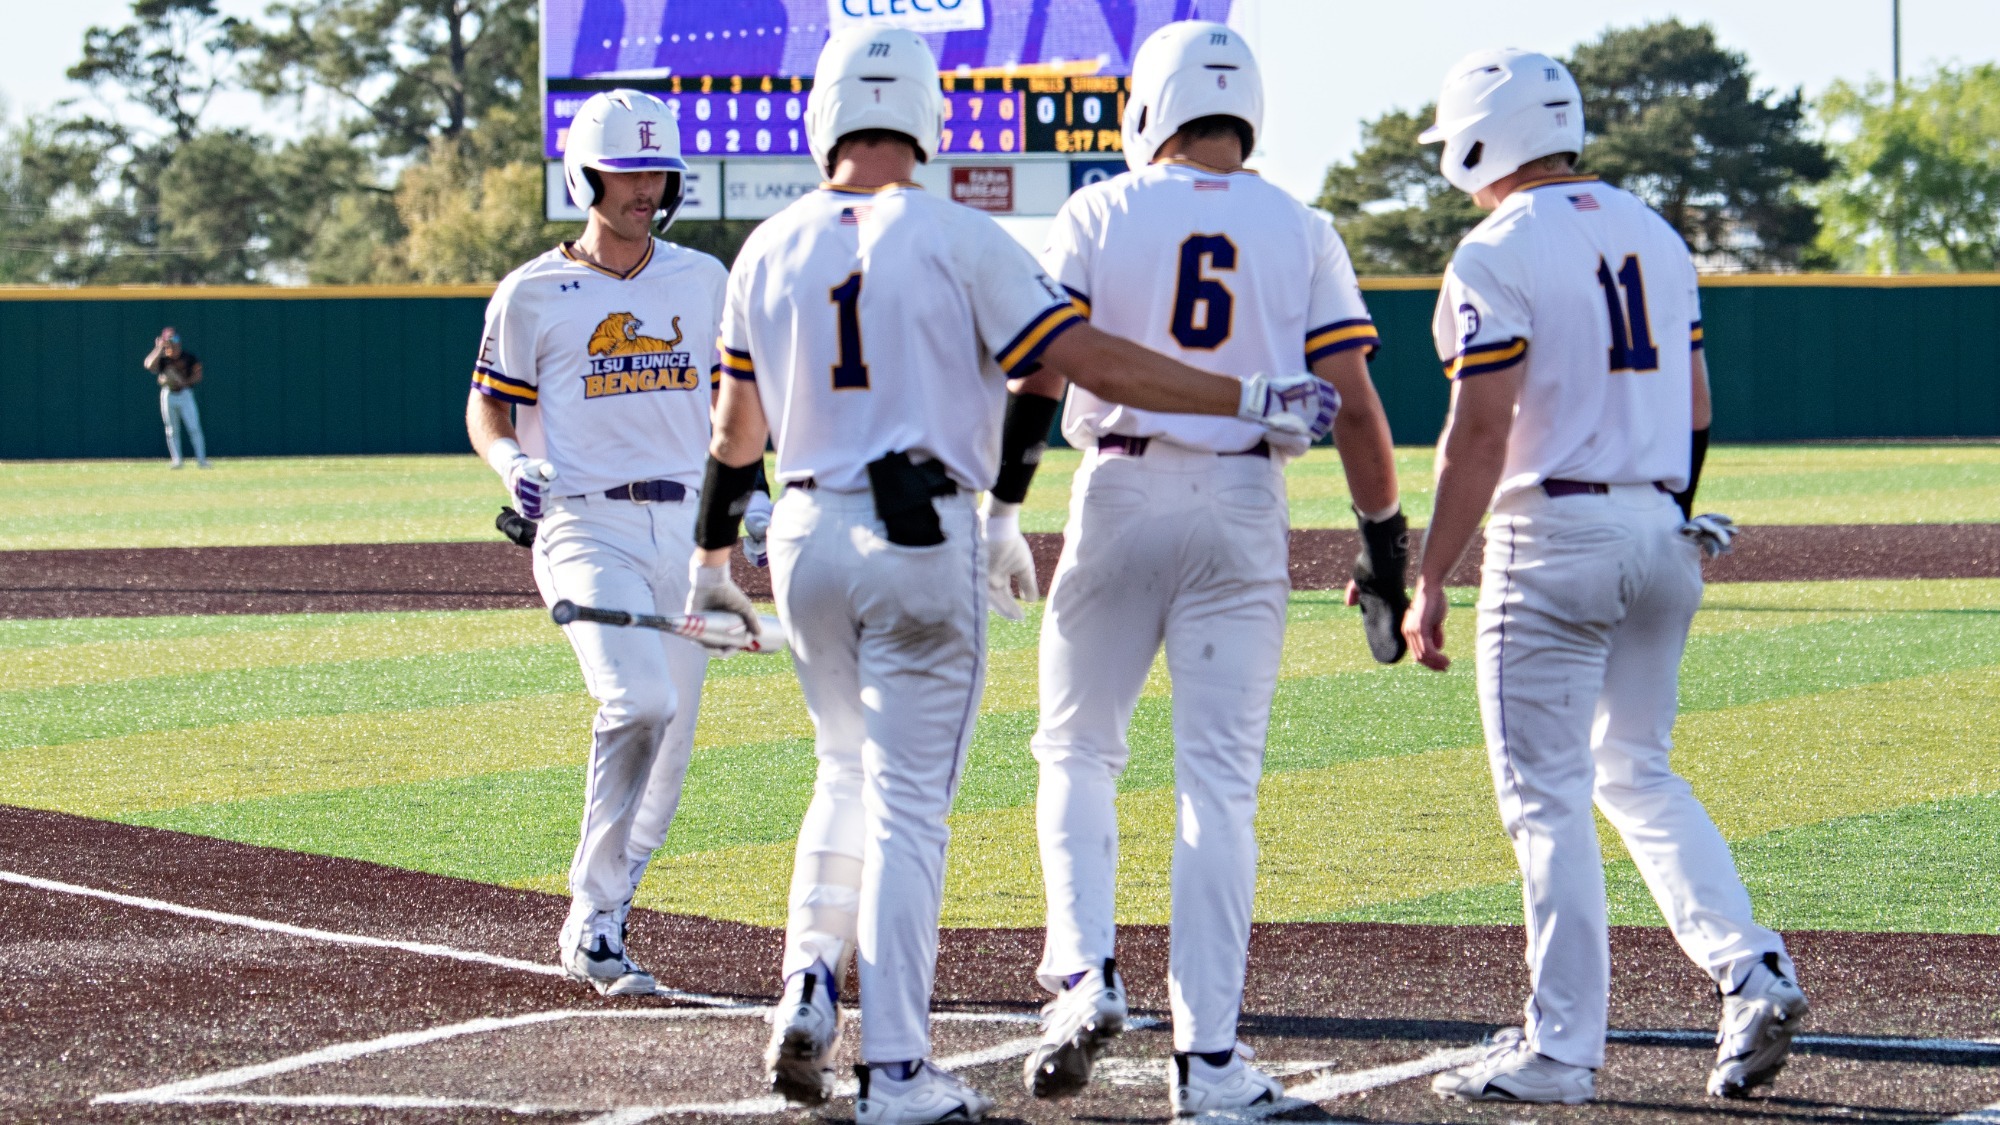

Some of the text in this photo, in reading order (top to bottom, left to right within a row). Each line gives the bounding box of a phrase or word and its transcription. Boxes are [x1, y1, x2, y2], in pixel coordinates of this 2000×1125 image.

[1217, 74, 1227, 90] 6
[695, 97, 711, 121] 0
[727, 97, 738, 121] 1
[755, 97, 771, 121] 0
[785, 97, 801, 121] 0
[967, 97, 983, 121] 7
[998, 97, 1014, 121] 0
[1036, 96, 1102, 124] 0 0
[637, 120, 661, 152] E
[695, 128, 712, 152] 0
[725, 128, 740, 152] 2
[755, 128, 771, 152] 0
[788, 128, 799, 152] 1
[968, 128, 984, 152] 4
[998, 128, 1014, 152] 0
[1055, 129, 1094, 152] 5:17
[1168, 232, 1238, 352] 6
[1597, 253, 1658, 374] 11
[829, 270, 870, 391] 1
[593, 354, 688, 374] LSU EUNICE
[585, 367, 698, 396] BENGALS
